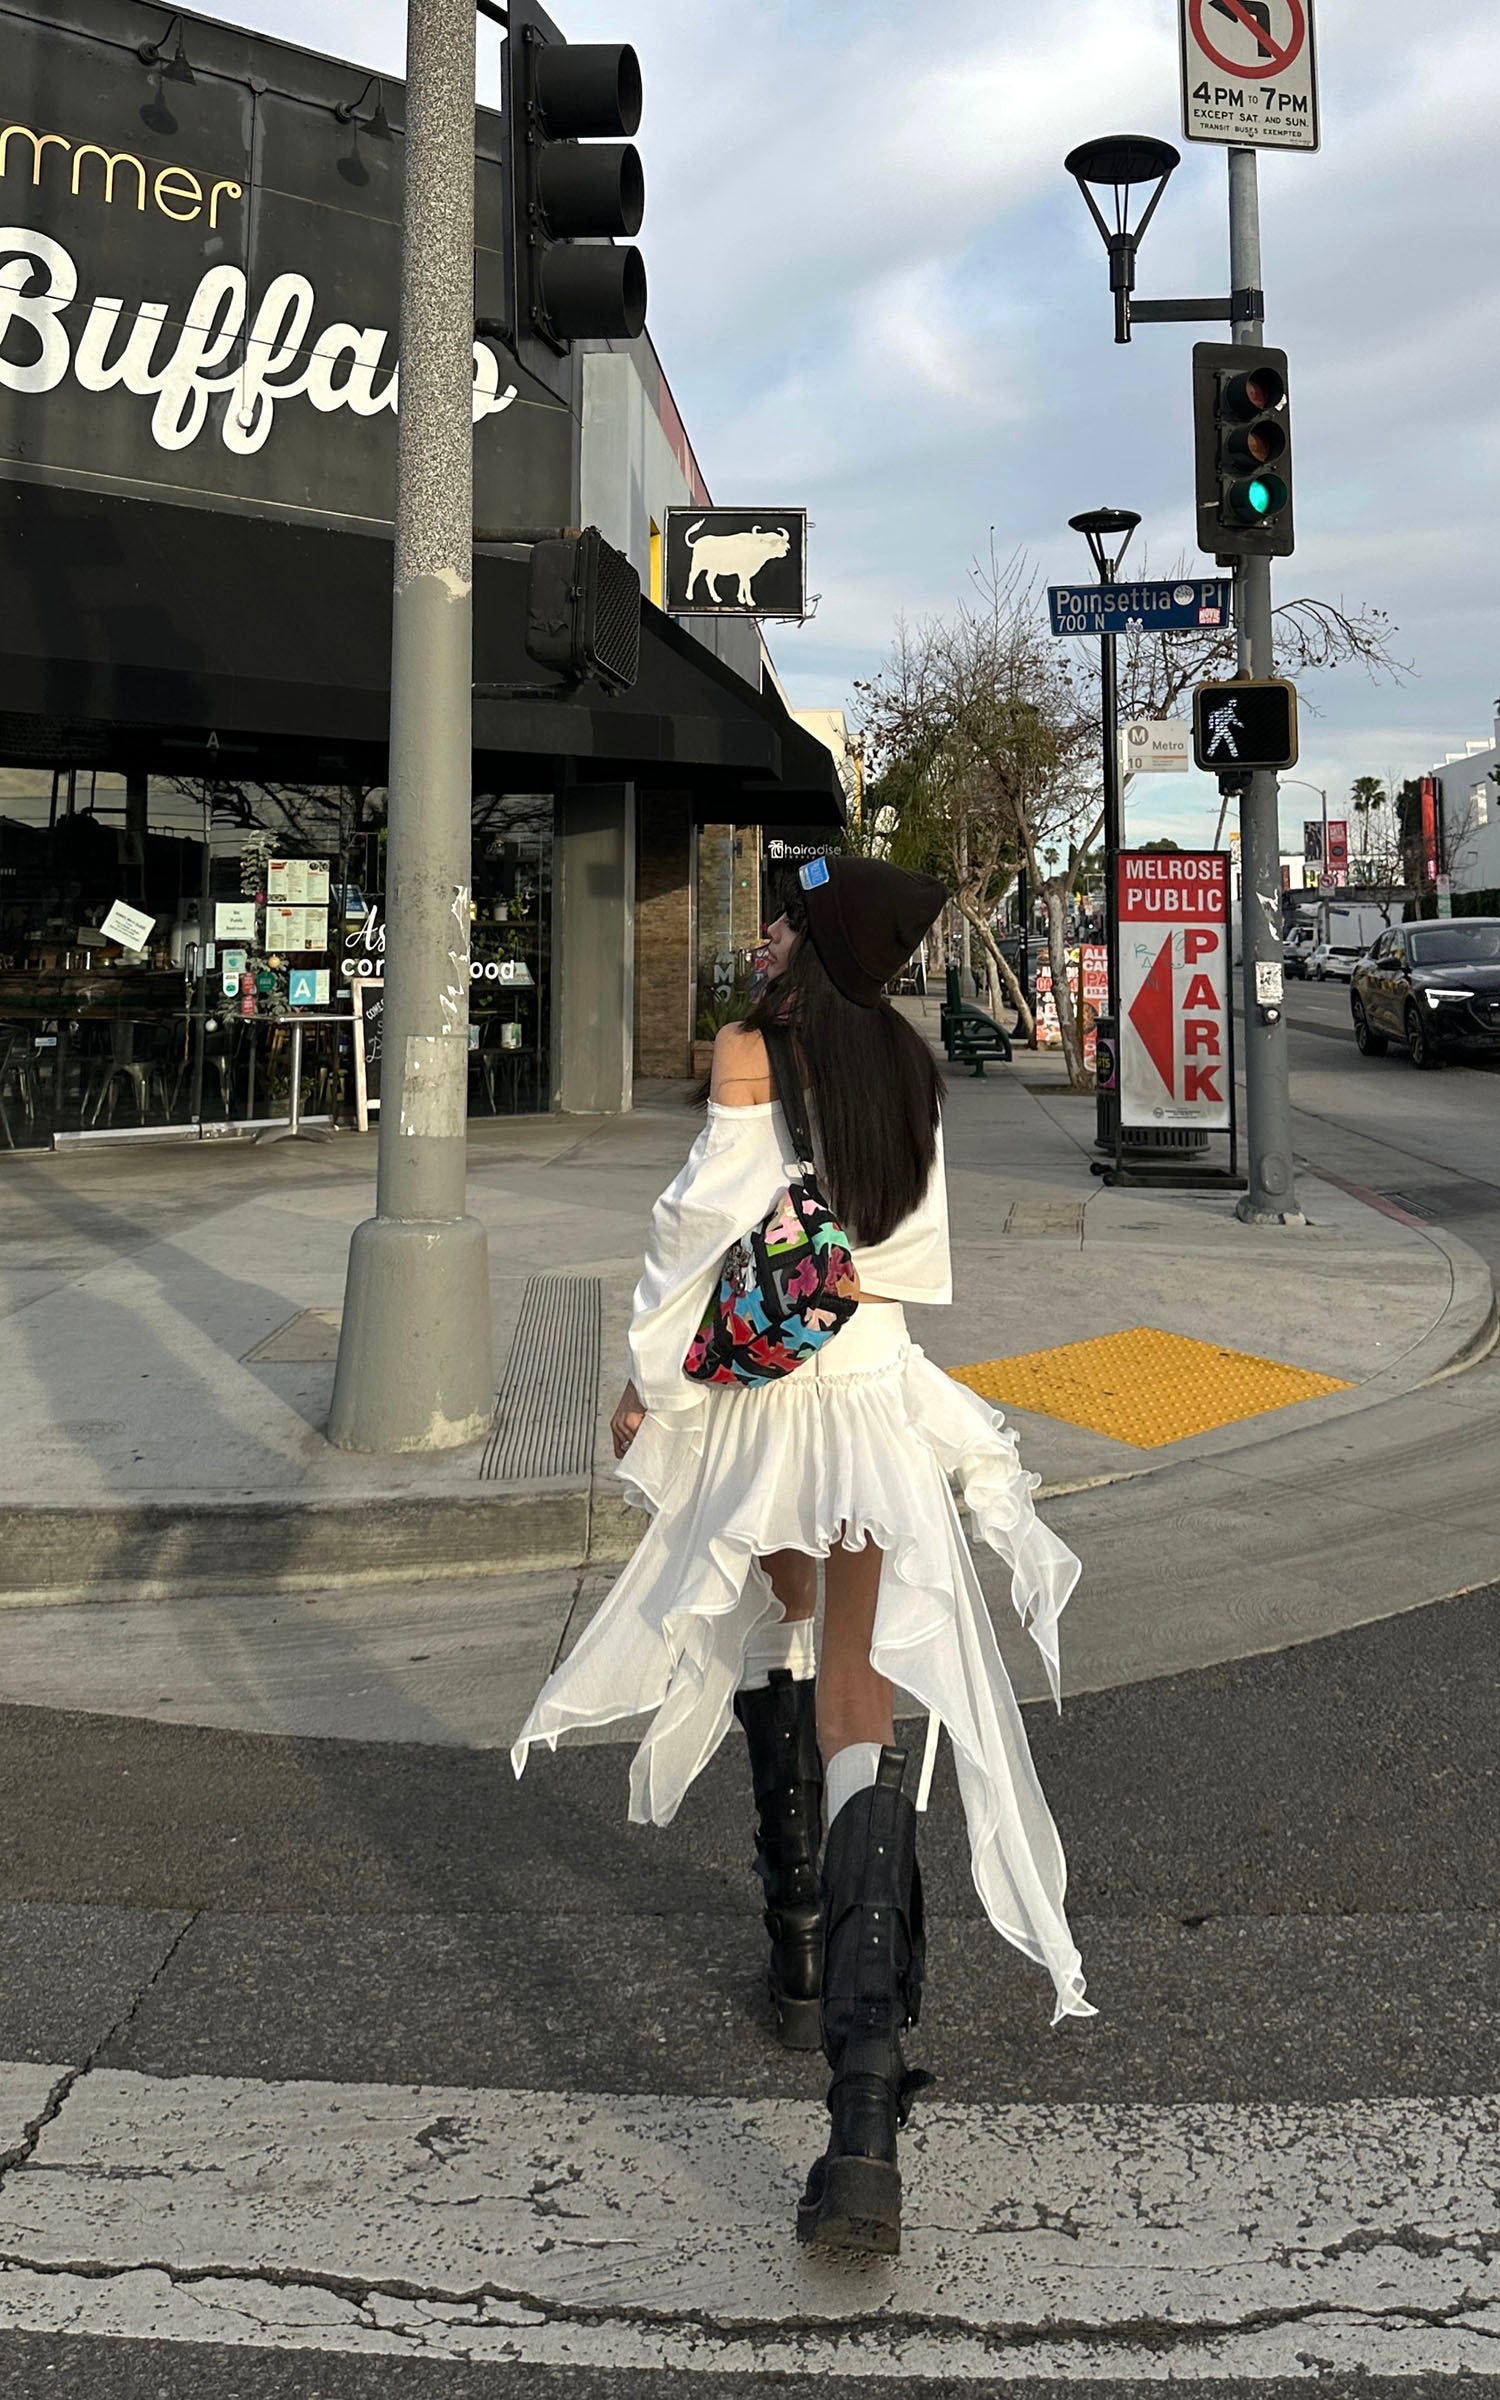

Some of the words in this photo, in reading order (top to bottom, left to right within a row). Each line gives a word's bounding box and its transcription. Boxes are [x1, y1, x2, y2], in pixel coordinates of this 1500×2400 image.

[1248, 95, 1258, 104] TO
[1194, 109, 1234, 120] EXCEPT
[1265, 116, 1281, 125] AND
[1200, 122, 1229, 131] TRANSIT
[1235, 126, 1258, 134] BUSES
[1263, 128, 1302, 138] EXEMPTED
[1057, 588, 1171, 615] Poinsettia
[1057, 614, 1087, 632] 700
[1095, 613, 1105, 631] N
[1152, 741, 1184, 751] Metro
[1129, 758, 1142, 769] 10
[784, 844, 842, 855] hairadise
[1126, 860, 1223, 880] MELROSE
[1127, 888, 1222, 912] PUBLIC
[294, 978, 312, 998] A
[1182, 928, 1225, 1102] PARK
